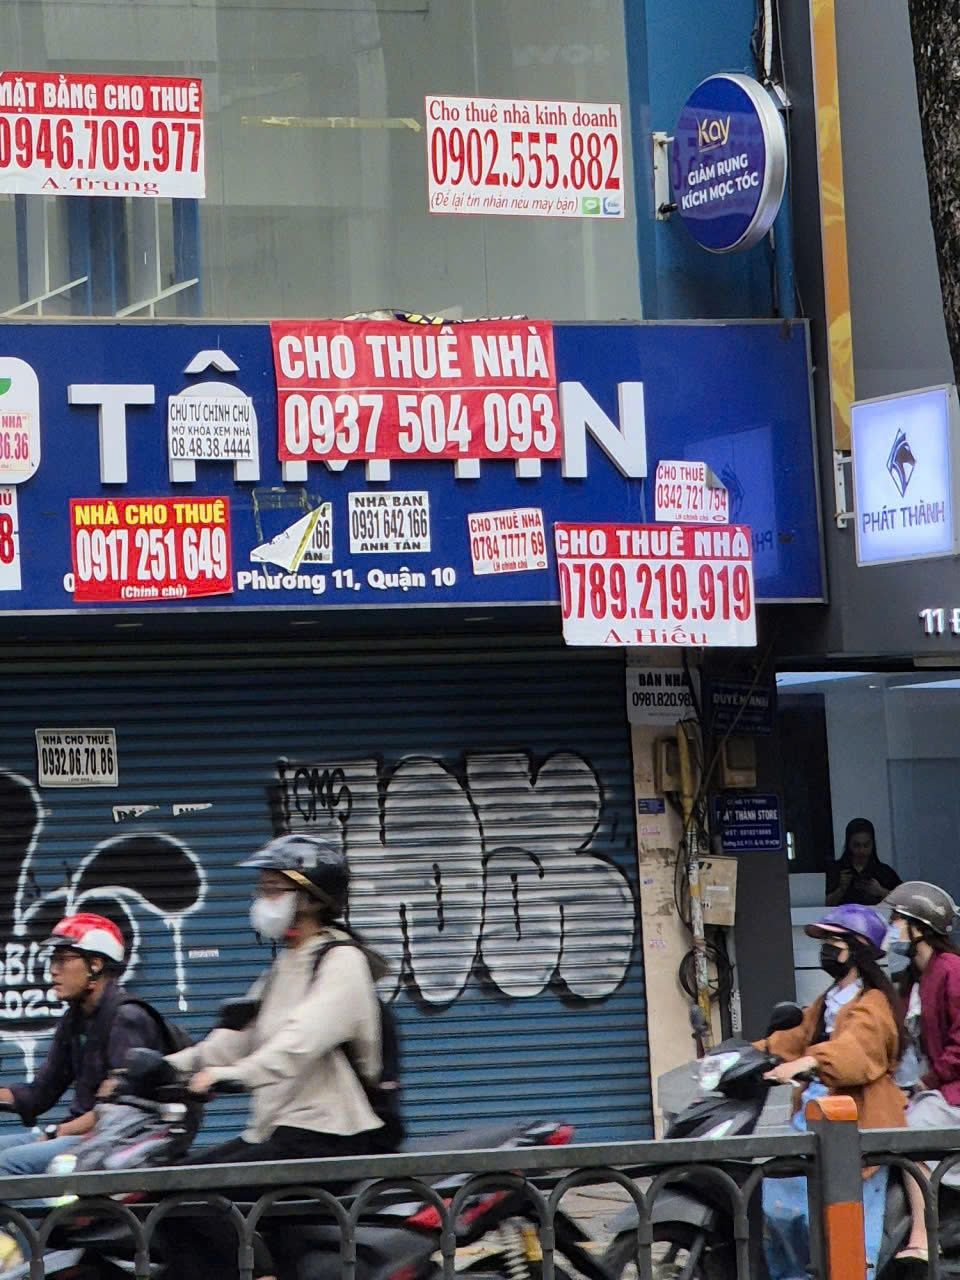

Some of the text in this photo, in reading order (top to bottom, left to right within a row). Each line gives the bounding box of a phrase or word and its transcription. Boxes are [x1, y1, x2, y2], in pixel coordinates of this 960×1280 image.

[43, 74, 97, 110] BẰNG
[104, 84, 143, 111] CHO
[150, 82, 200, 112] THUÊ
[430, 100, 618, 128] Cho thuê nhà kinh doanh
[431, 126, 620, 190] 0902.555.882
[688, 153, 748, 186] GIẢM RỤNG
[681, 171, 759, 210] KÍCH MỌC TÓC
[278, 324, 549, 380] CHO THUÊ NHÀ
[203, 398, 230, 422] CHÍNH
[284, 392, 557, 455] 0937 504 093
[213, 426, 230, 436] XEM
[171, 437, 251, 458] 08.48.38.4444
[658, 464, 704, 482] CHO THUÊ
[657, 484, 682, 509] 0342
[686, 485, 704, 510] 721
[75, 499, 225, 525] NHÀ CHO THUÊ
[352, 508, 428, 540] 0931 642 166
[470, 517, 491, 533] CHO
[493, 512, 519, 531] THUÊ
[862, 499, 945, 533] PHÁT THÀNH
[76, 527, 227, 582] 0917 251 649
[360, 542, 389, 551] ANH
[472, 531, 544, 561] 0784 7777 69
[555, 529, 607, 556] CHO
[616, 526, 685, 556] THUÊ
[694, 527, 749, 557] NHÀ
[332, 567, 456, 591] 11, Quận 10
[559, 562, 751, 621] 0789.219.919
[64, 735, 84, 745] CHO
[42, 747, 113, 776] 0932.06.70.86
